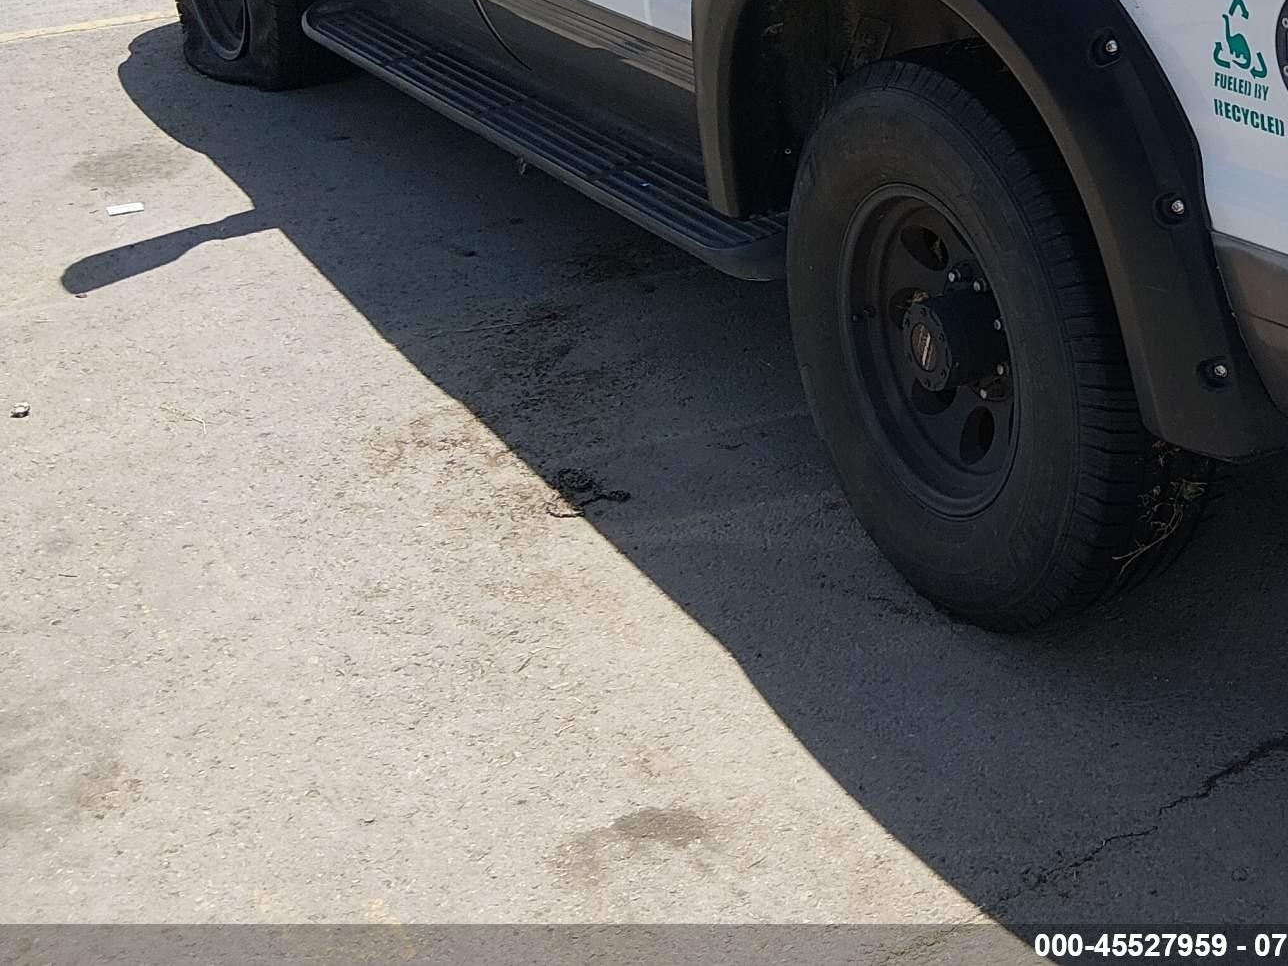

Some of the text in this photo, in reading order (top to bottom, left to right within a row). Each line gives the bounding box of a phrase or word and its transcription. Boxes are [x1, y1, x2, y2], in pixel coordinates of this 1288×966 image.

[1214, 72, 1269, 101] FUELED BY
[1214, 98, 1285, 137] RECYCLED
